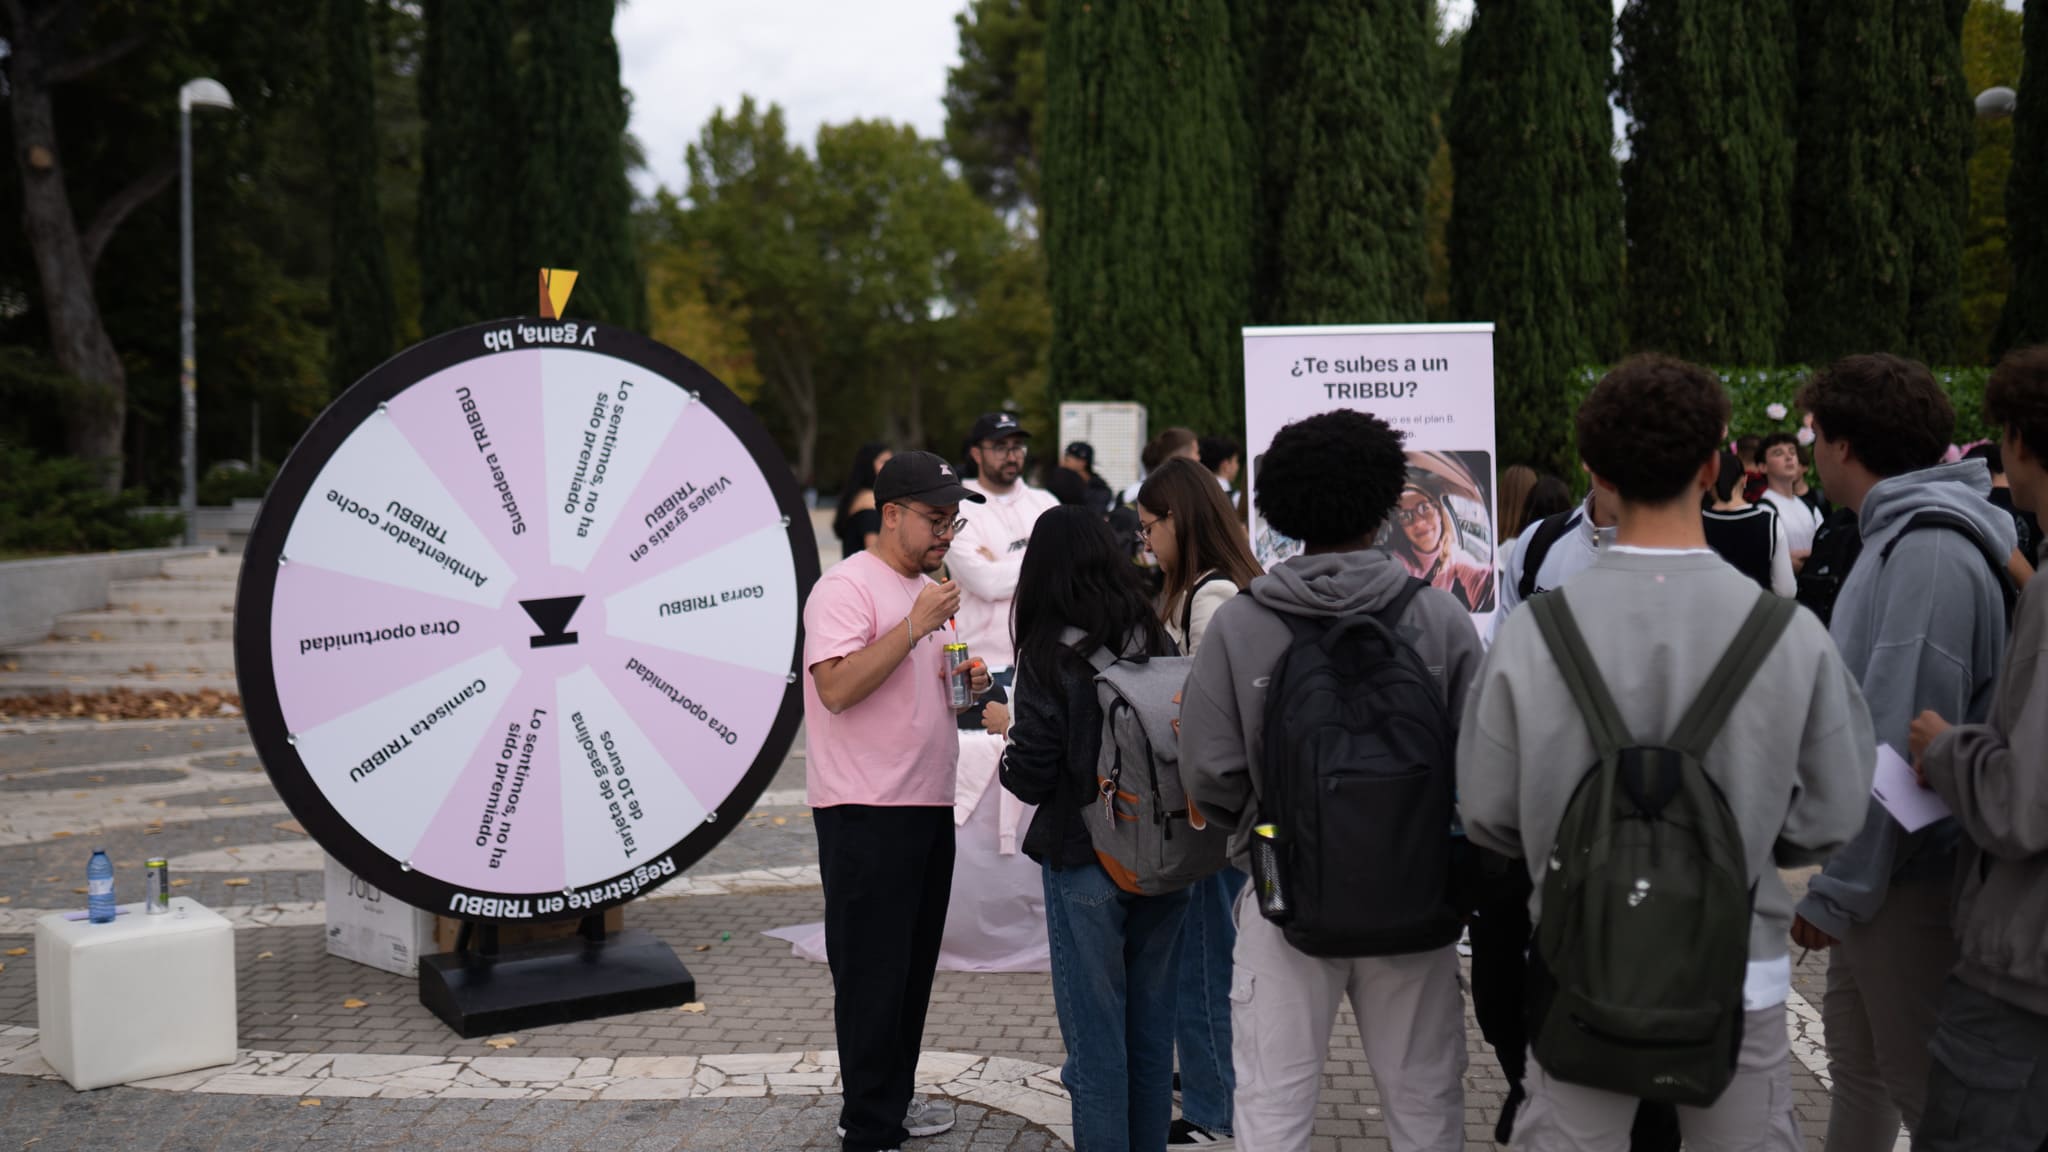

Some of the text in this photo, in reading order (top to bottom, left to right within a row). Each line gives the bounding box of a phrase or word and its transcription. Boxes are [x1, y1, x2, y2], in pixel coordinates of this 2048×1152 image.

[483, 323, 597, 352] y gana, bb
[1291, 355, 1448, 377] ¿Te subes a un
[1324, 381, 1418, 399] TRIBBU?
[1424, 416, 1445, 426] plan
[456, 387, 526, 535] Sudadera TRIBBU
[564, 392, 608, 514] sido premiado
[577, 380, 633, 537] Lo sentimos, no ha
[327, 490, 488, 587] Ambientador coche
[386, 501, 447, 544] TRIBBU
[630, 477, 731, 562] Viajes gratis en
[645, 482, 697, 528] TRIBBU
[300, 620, 460, 655] Otra oportunidad
[659, 585, 764, 617] Gorra TRIBBU
[350, 679, 486, 783] Camiseta TRIBBU
[625, 658, 737, 745] Otra oportunidad
[476, 723, 521, 846] sido premiado
[489, 709, 547, 868] Lo sentimos, no ha
[572, 712, 637, 858] Tarjeta de gasolina
[600, 731, 643, 820] de 10 euros
[449, 856, 677, 918] Regístrate en TRIBBU
